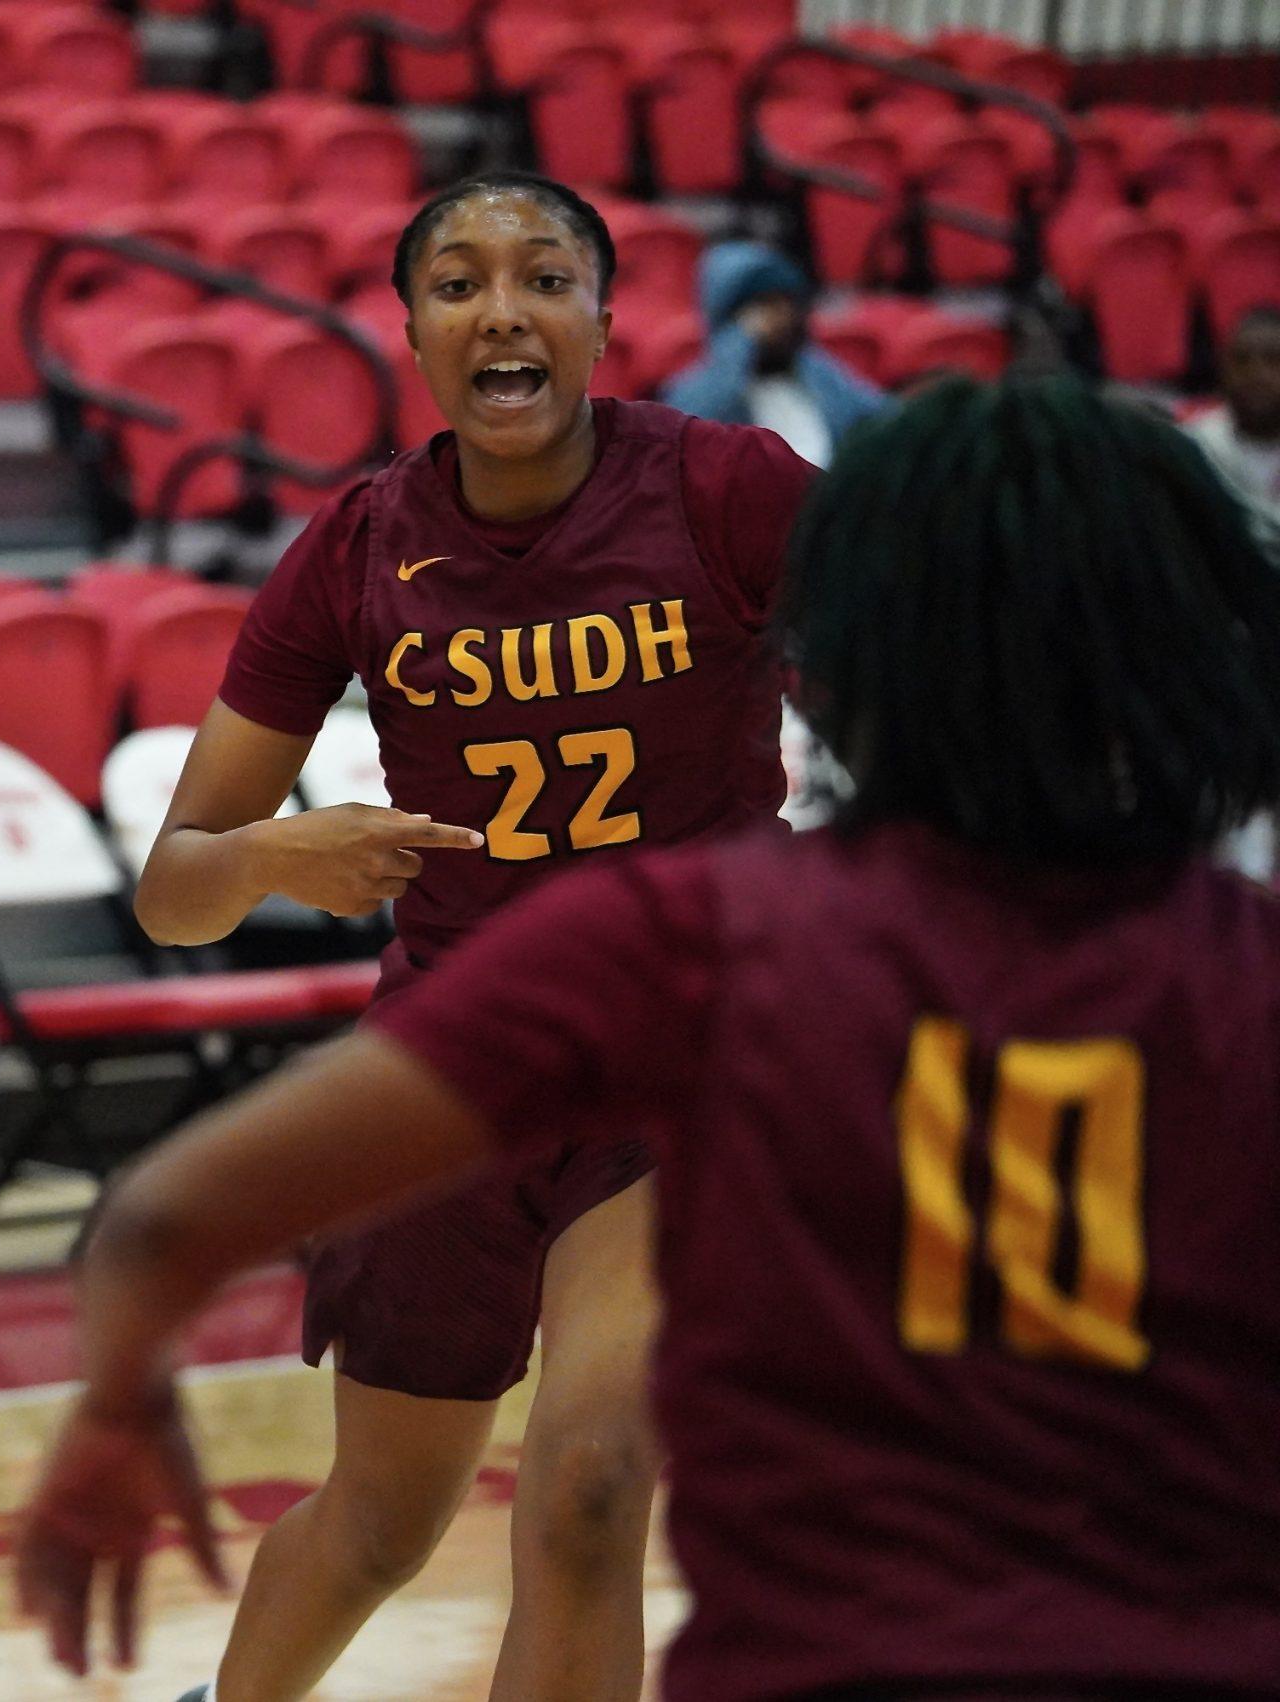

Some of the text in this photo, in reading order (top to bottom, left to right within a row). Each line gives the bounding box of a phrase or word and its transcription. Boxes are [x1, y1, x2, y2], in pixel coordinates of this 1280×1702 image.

[384, 599, 694, 708] CSUDH
[463, 727, 641, 861] 22
[895, 1017, 1150, 1372] 10
